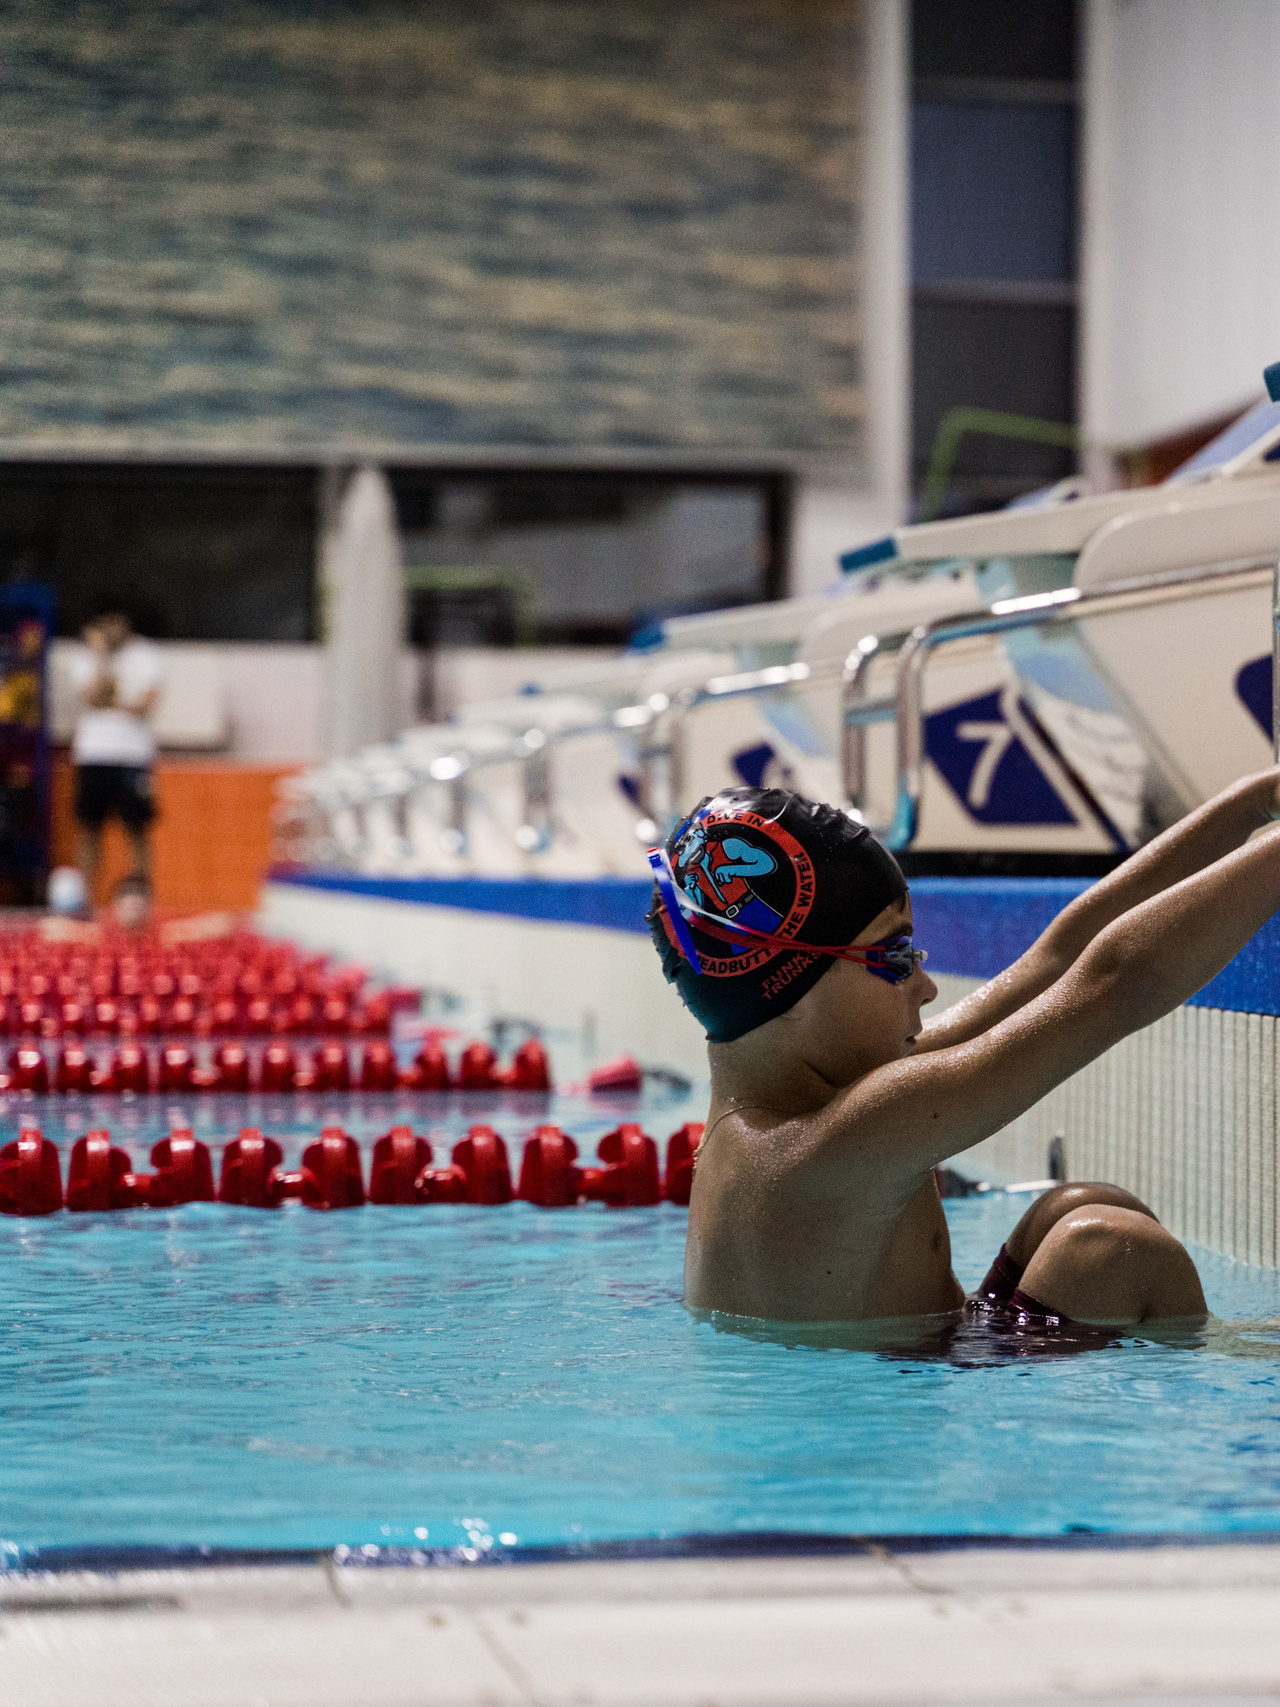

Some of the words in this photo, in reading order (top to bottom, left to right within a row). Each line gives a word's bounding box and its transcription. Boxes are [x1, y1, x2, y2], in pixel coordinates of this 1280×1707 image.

[956, 721, 1011, 808] 7
[747, 815, 764, 827] IN
[697, 947, 771, 974] EADBUTT
